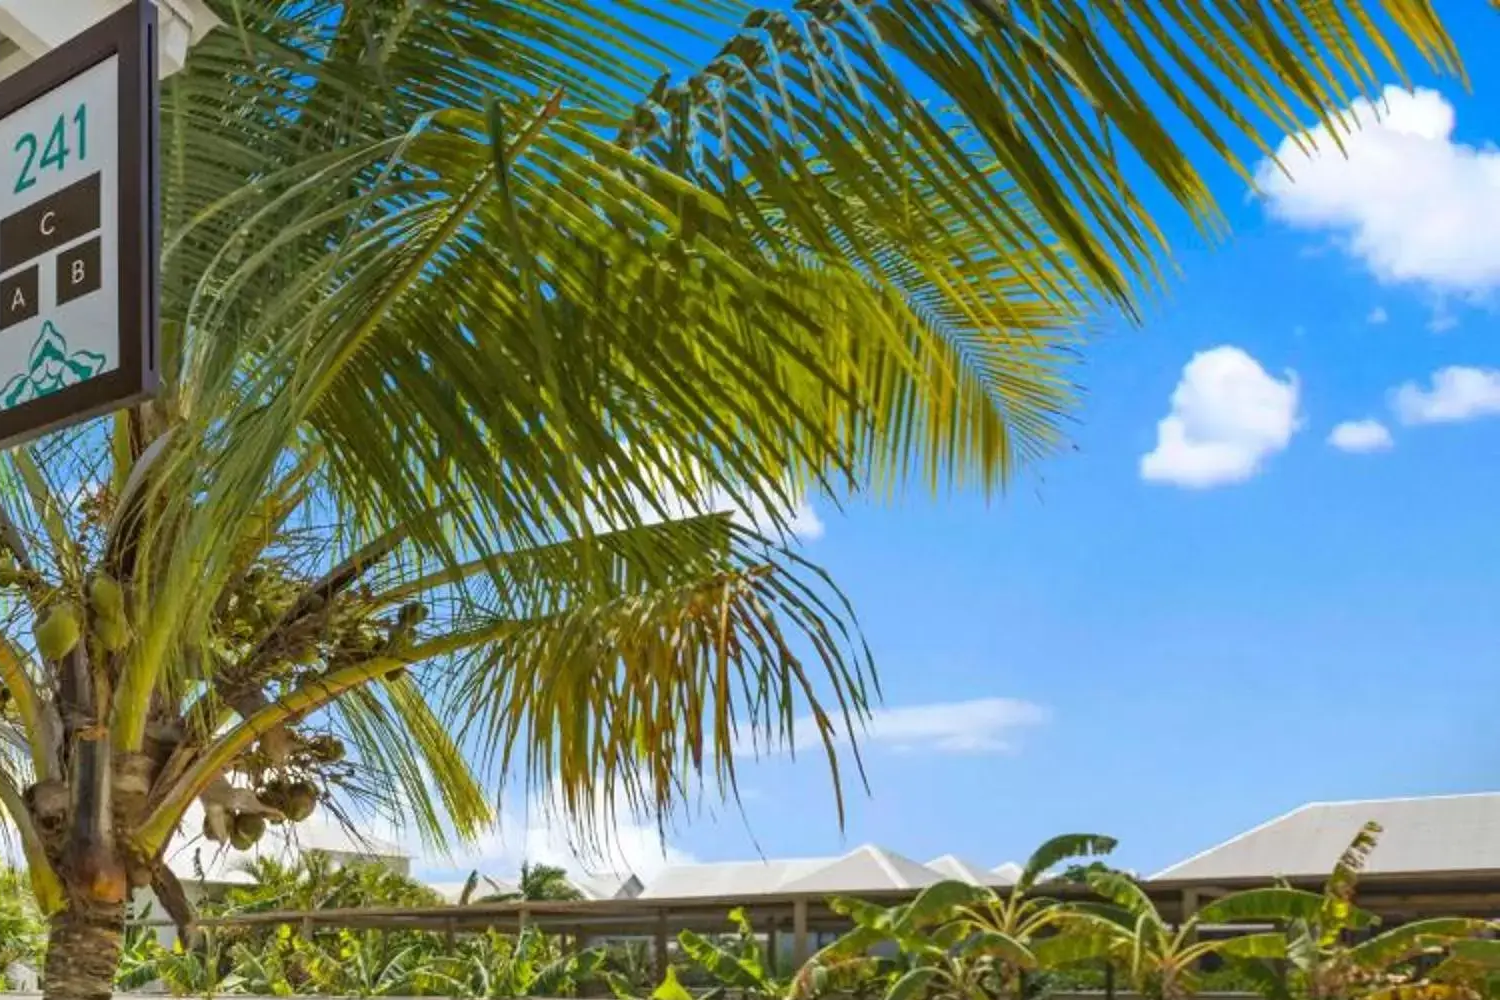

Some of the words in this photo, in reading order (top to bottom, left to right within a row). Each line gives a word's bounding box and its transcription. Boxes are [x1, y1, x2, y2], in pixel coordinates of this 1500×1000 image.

[13, 103, 86, 195] 241
[40, 211, 56, 235] C
[72, 259, 85, 285] B
[11, 288, 25, 312] A
